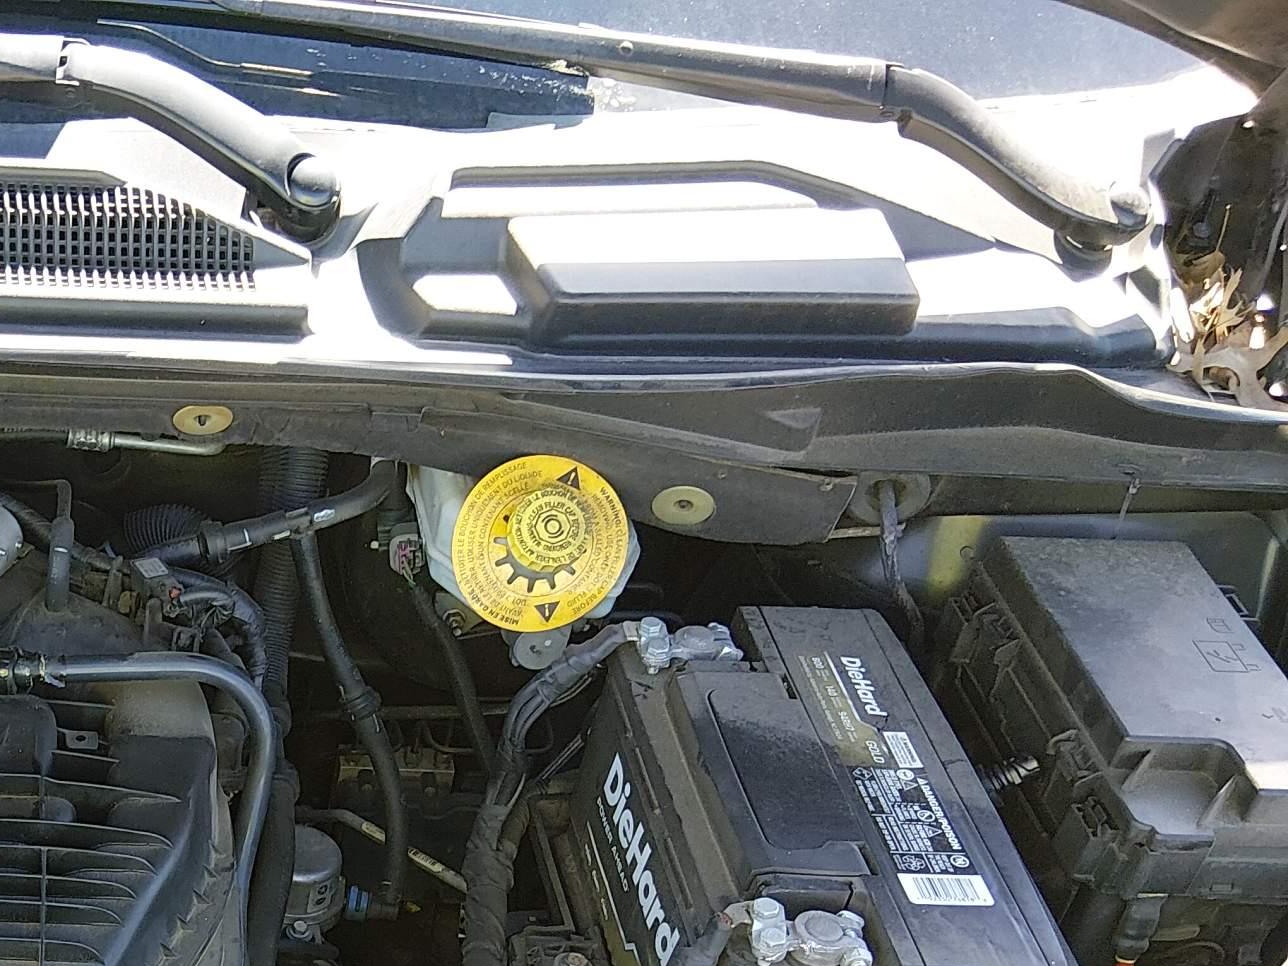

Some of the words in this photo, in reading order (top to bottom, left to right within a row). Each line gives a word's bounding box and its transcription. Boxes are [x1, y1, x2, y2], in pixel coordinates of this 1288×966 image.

[571, 593, 597, 614] BEFORE
[840, 656, 889, 717] DieHard
[596, 796, 613, 845] POWER
